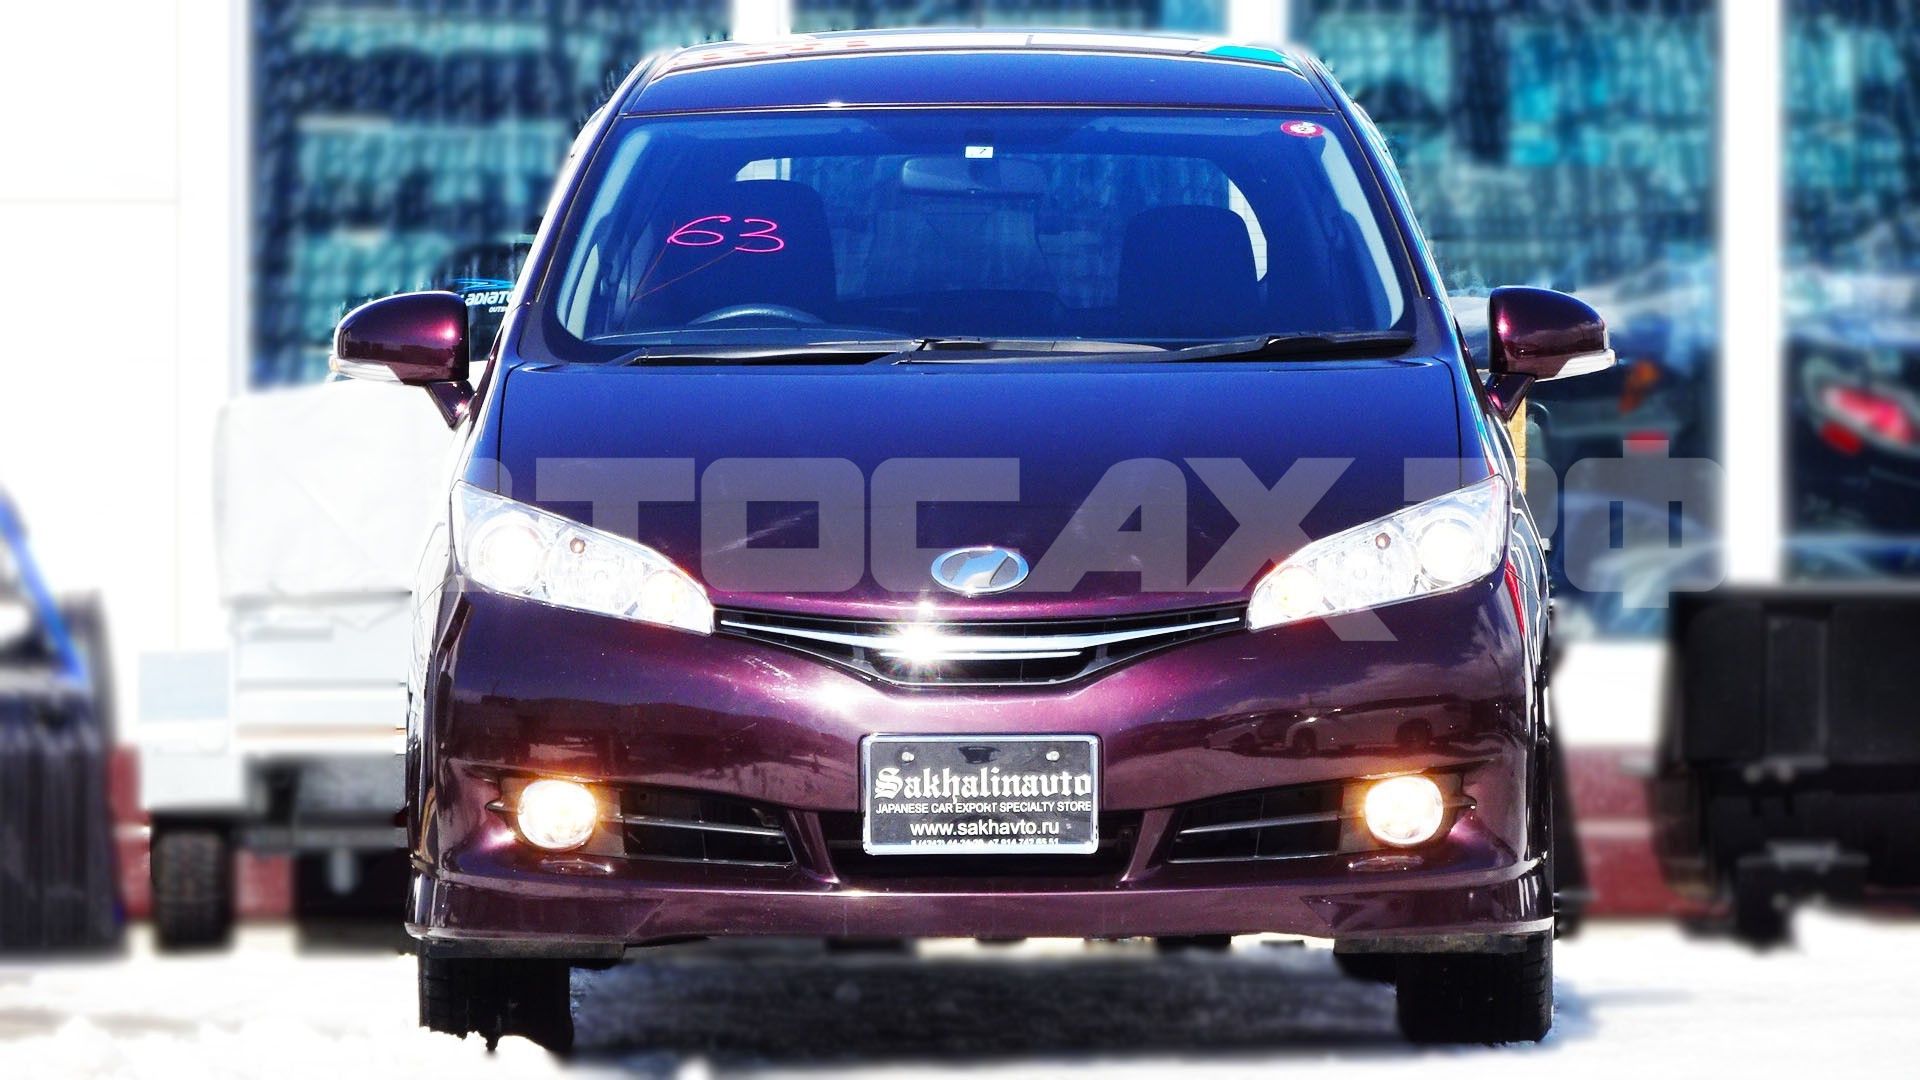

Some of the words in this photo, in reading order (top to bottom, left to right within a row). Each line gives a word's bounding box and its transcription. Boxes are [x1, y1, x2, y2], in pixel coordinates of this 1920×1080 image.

[667, 215, 785, 252] 63
[874, 767, 1092, 803] Sakhalinauto
[876, 803, 929, 814] JAPANESE
[931, 803, 953, 814] CAR
[955, 802, 997, 813] EXPORT
[999, 801, 1054, 813] SPECIALTY
[1057, 801, 1092, 812] STORE
[910, 819, 1060, 836] www.sakhavto.ru
